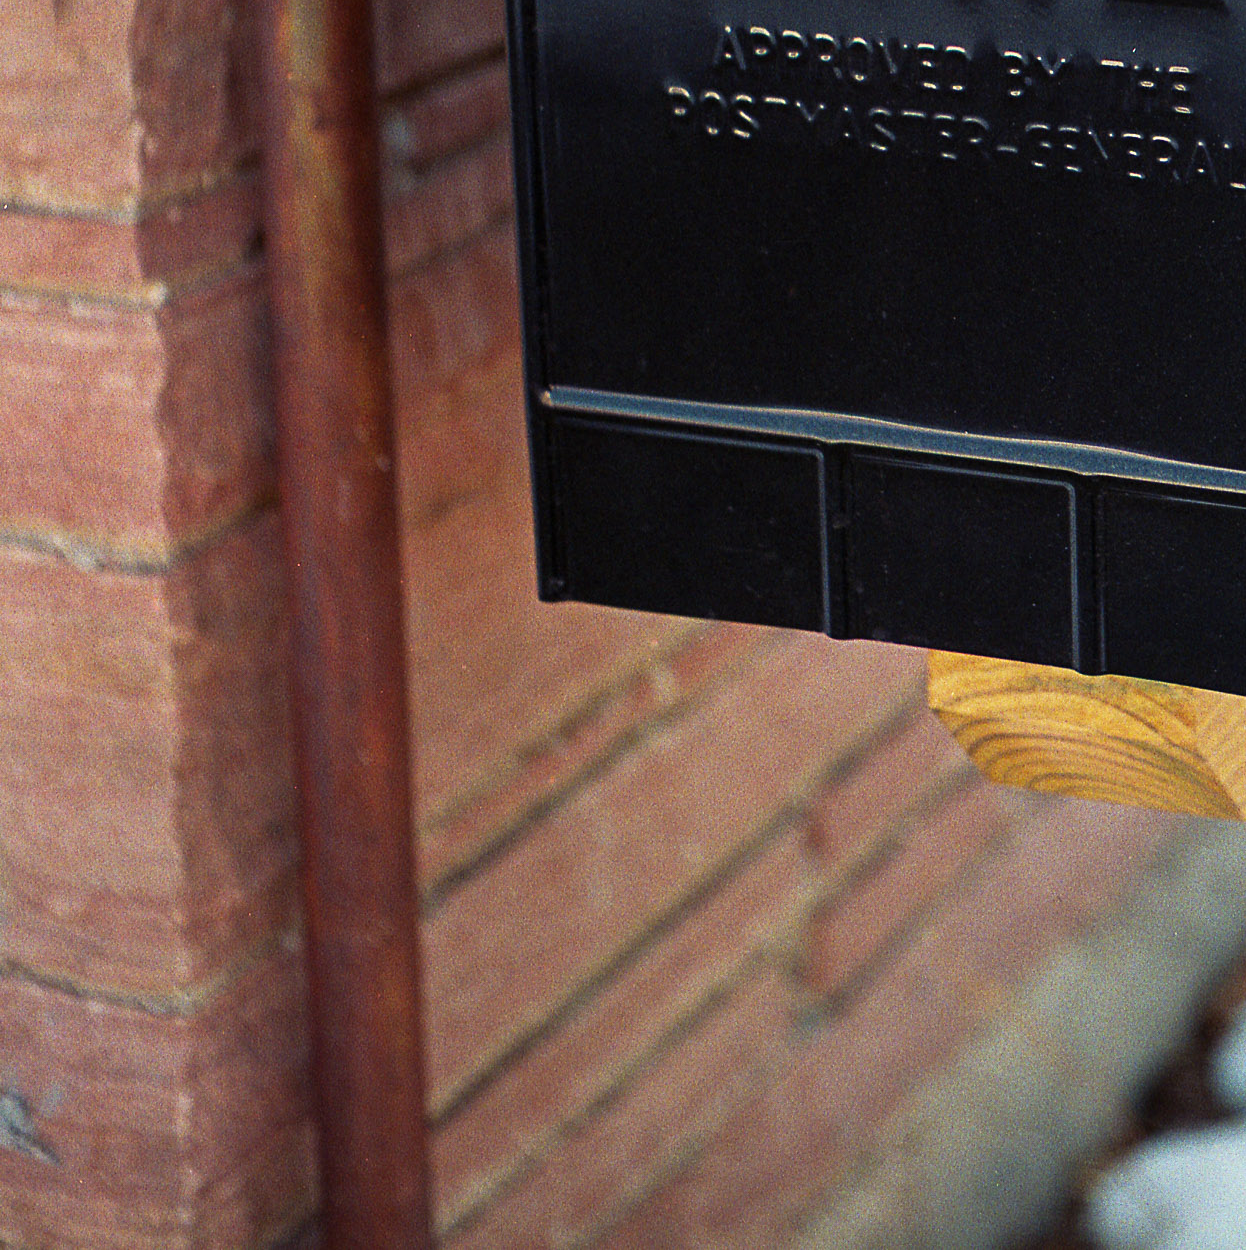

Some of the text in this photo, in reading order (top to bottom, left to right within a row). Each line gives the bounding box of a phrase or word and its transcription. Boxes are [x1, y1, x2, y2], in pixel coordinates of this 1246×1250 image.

[713, 24, 1196, 114] APPROVED BY THE
